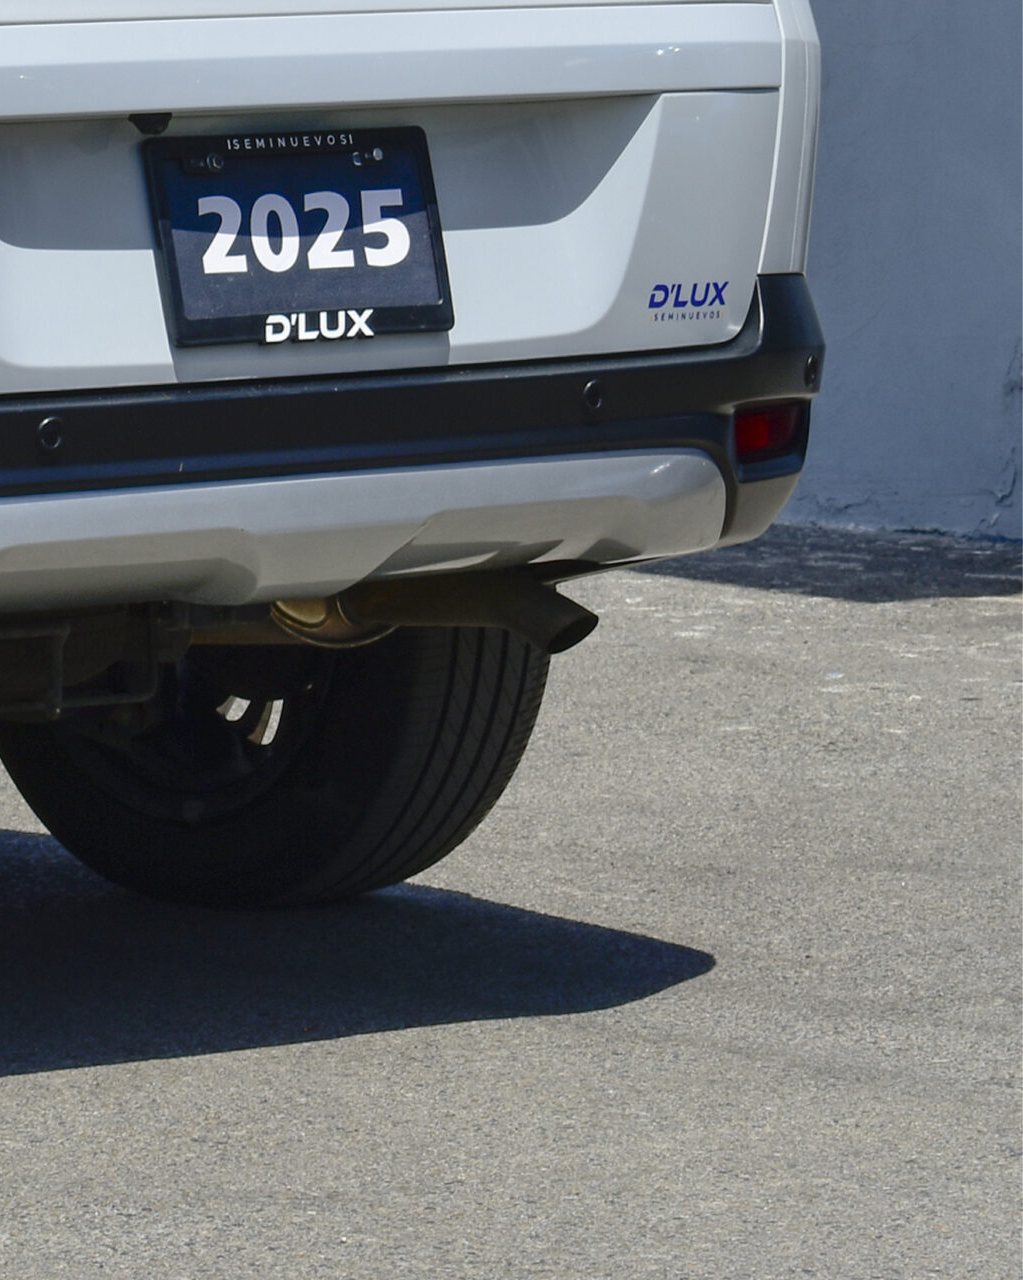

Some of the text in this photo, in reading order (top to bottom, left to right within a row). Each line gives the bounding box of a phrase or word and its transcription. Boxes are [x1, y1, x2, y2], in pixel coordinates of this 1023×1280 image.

[197, 188, 411, 274] 2025
[649, 281, 729, 309] D'LUX
[264, 308, 375, 344] D'LUX
